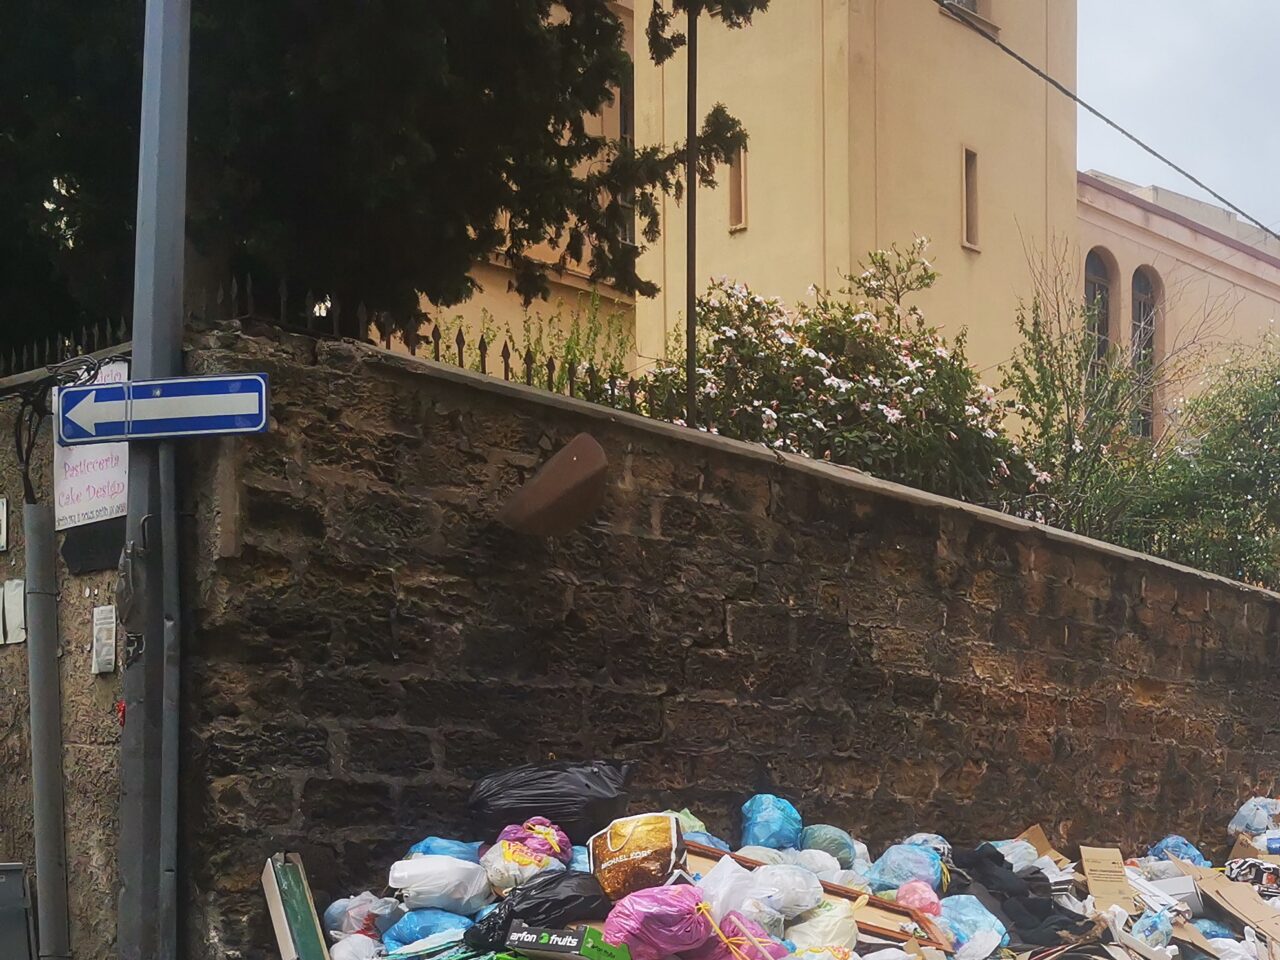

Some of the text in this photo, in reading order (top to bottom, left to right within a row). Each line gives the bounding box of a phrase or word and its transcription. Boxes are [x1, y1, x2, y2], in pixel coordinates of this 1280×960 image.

[86, 480, 125, 499] Design
[601, 854, 627, 869] MICHAEL
[549, 934, 579, 947] fruits
